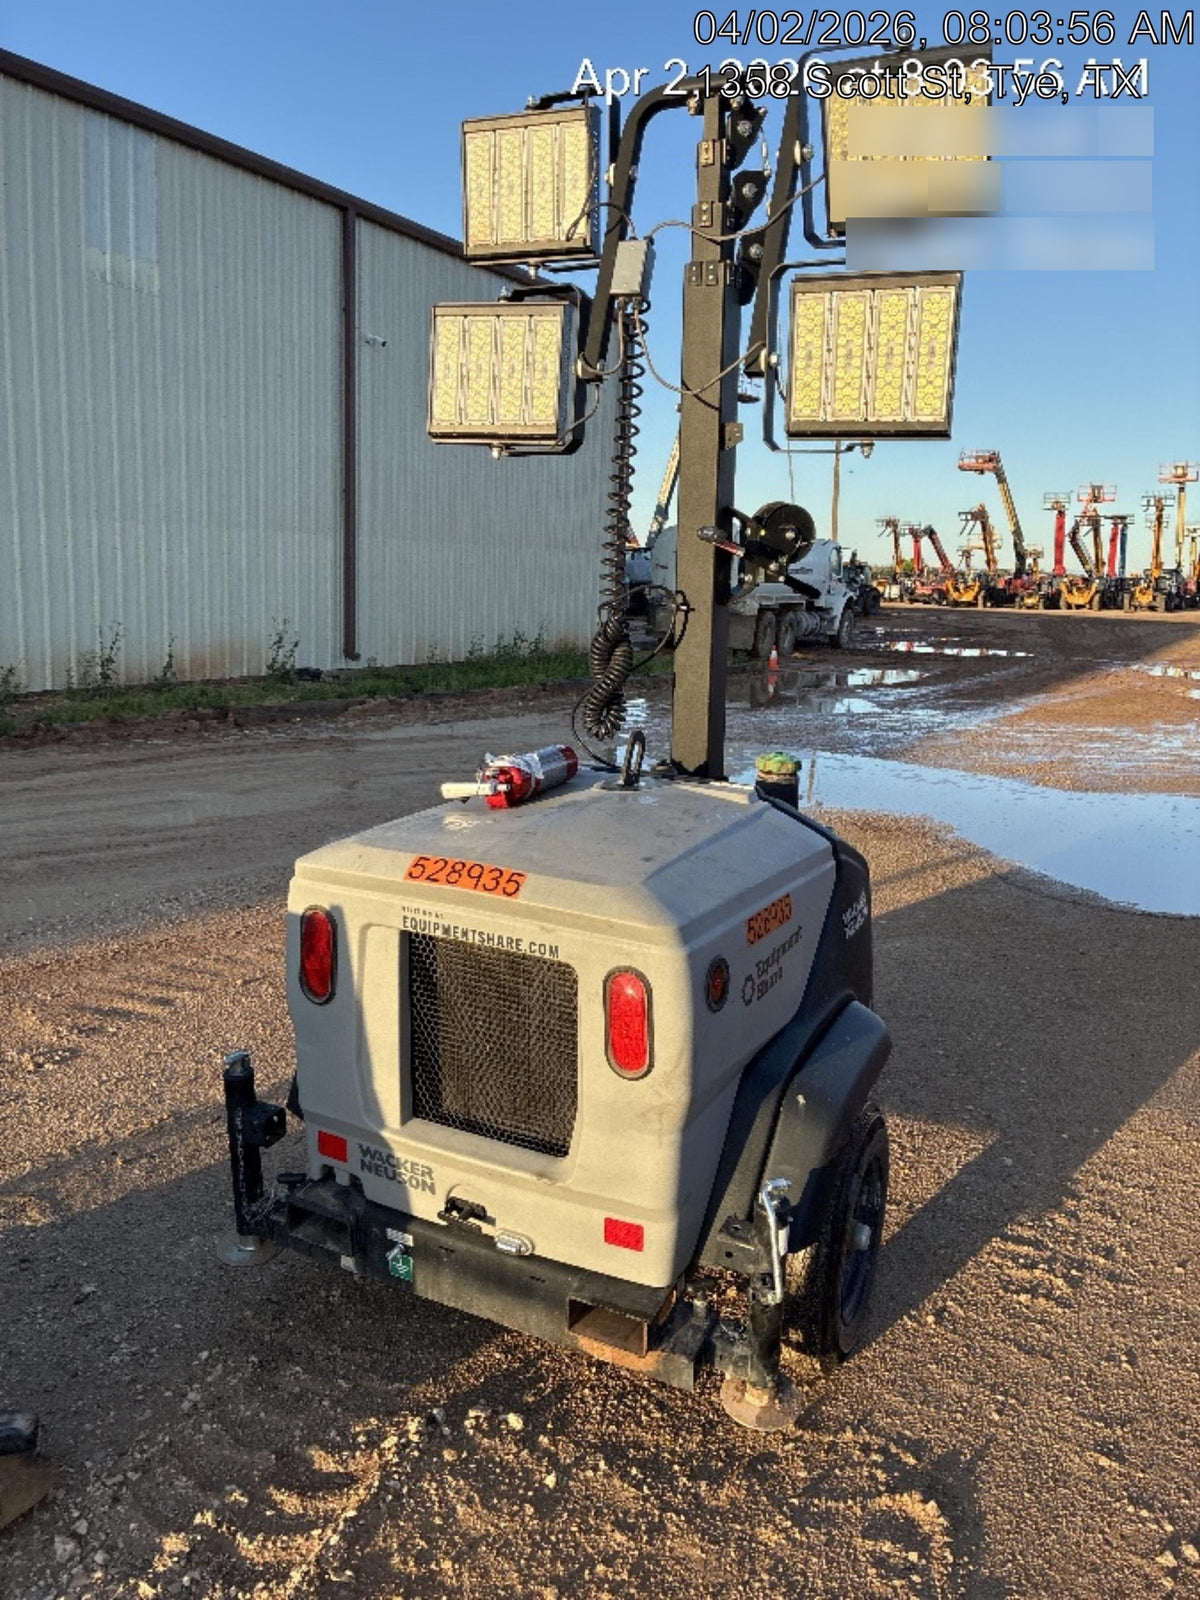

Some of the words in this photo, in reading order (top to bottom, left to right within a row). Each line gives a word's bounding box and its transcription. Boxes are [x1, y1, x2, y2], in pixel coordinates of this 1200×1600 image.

[408, 856, 525, 896] 528935
[402, 915, 560, 960] EQUIPMENTSHARE.COM
[359, 1143, 434, 1181] WACKER
[361, 1159, 436, 1195] NEUSON
